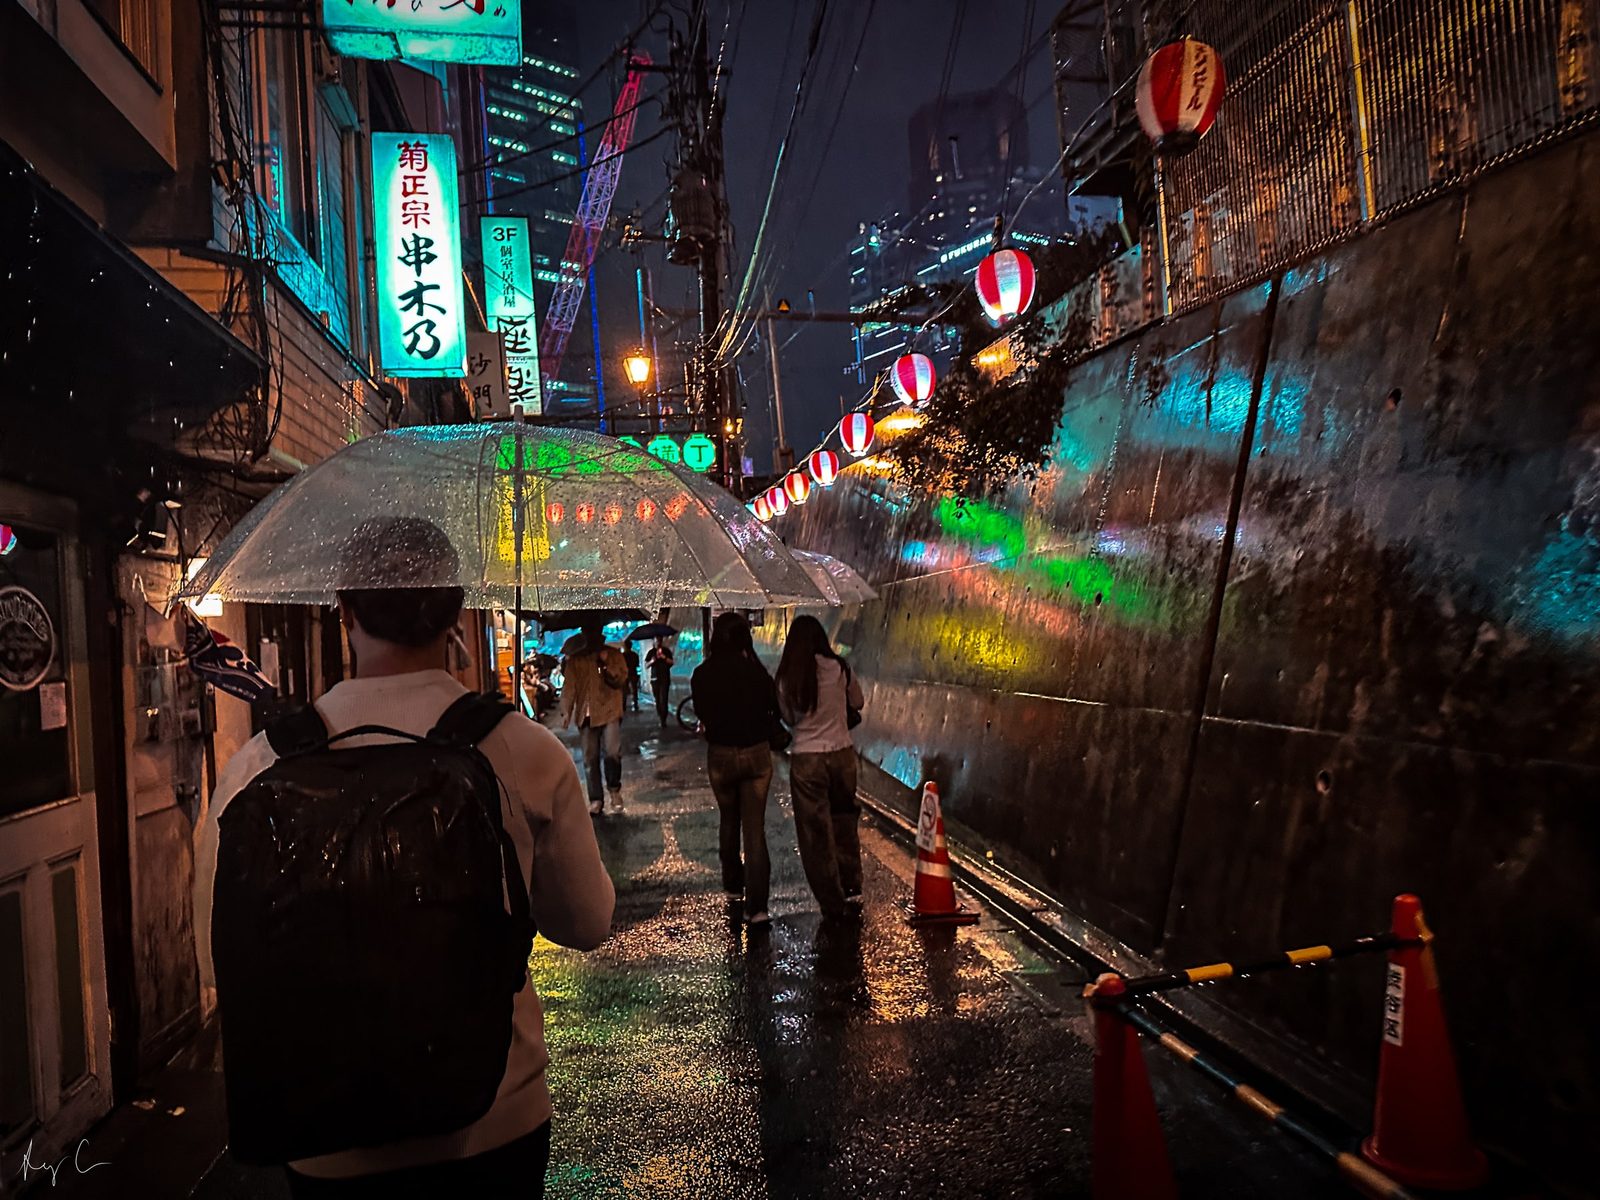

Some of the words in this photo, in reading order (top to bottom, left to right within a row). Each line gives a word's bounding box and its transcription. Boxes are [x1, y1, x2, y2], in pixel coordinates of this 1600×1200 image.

[397, 141, 431, 229] 菊正宗
[492, 226, 518, 242] 3F
[397, 233, 447, 360] 串木乃
[499, 245, 516, 308] 個室居酒屋
[469, 352, 493, 409] 沙門
